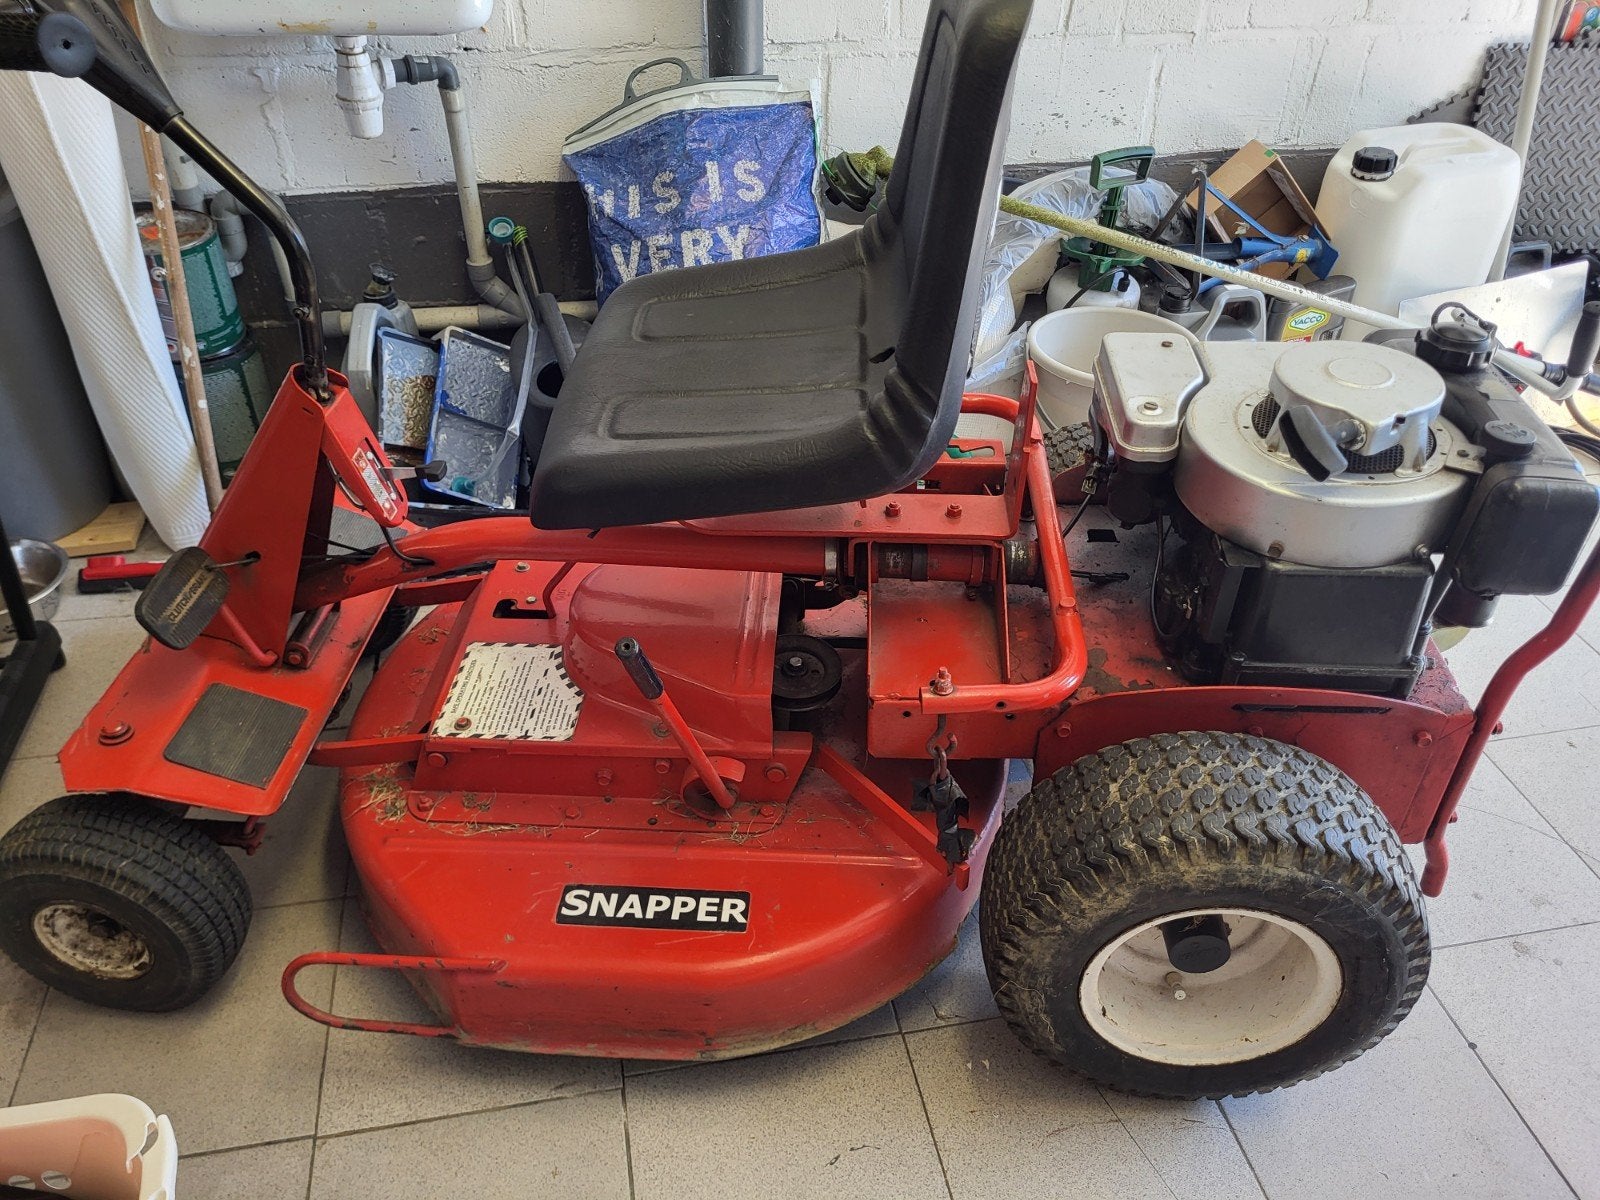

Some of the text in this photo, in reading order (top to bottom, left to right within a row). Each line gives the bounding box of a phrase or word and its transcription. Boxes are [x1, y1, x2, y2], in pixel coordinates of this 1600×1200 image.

[705, 159, 766, 203] IS
[610, 224, 751, 282] VERY
[1294, 315, 1323, 326] YACCO
[560, 889, 748, 924] SNAPPER
